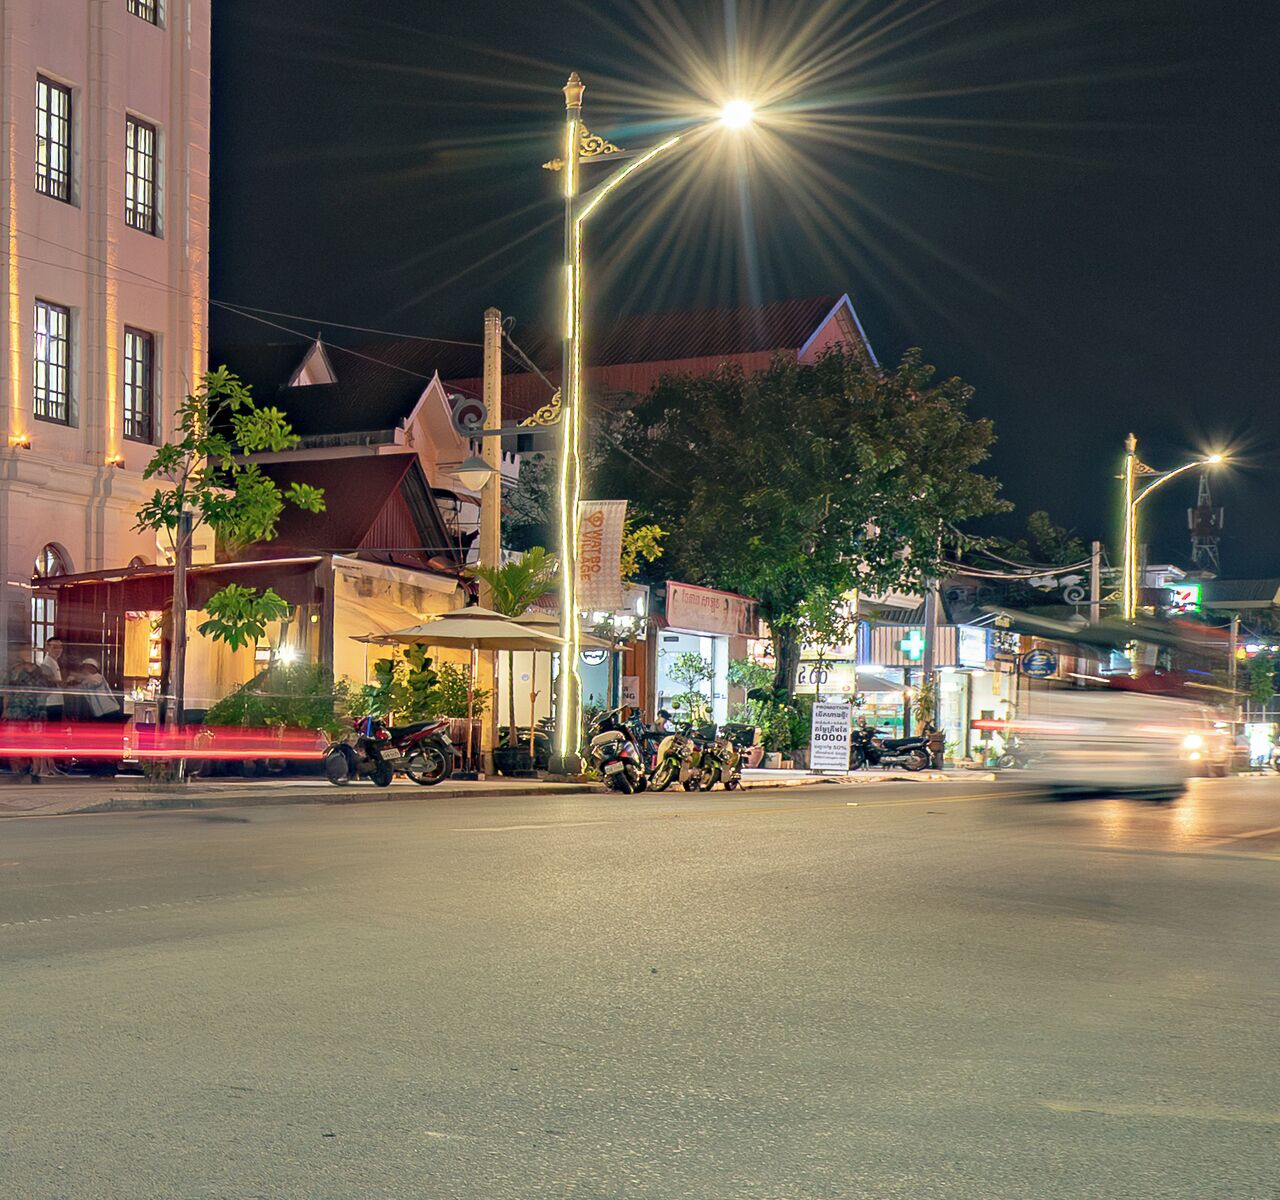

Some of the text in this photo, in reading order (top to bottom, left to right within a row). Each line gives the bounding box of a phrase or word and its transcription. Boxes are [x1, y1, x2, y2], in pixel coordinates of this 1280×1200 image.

[581, 530, 593, 582] VILLAGE
[591, 528, 603, 573] WAT BO
